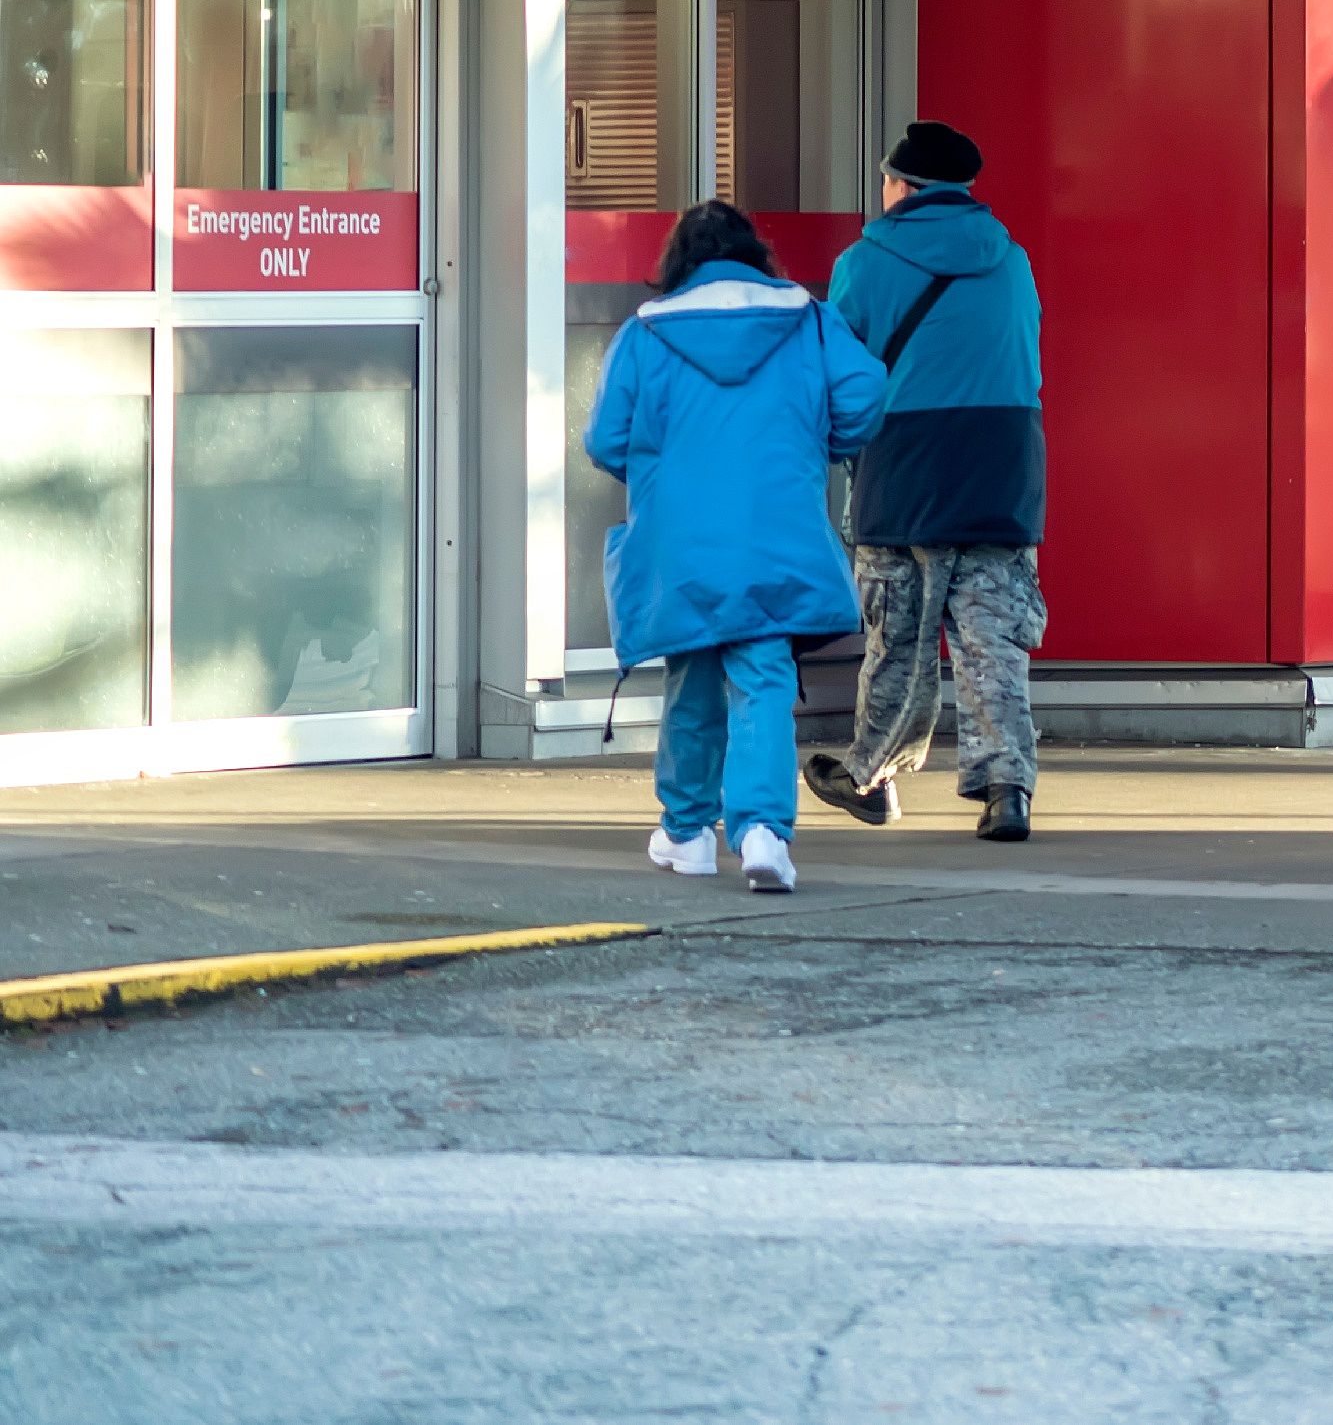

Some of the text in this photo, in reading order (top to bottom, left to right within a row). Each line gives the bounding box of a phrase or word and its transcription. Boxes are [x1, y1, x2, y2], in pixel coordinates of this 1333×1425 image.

[187, 203, 381, 241] Emergency Entrance
[260, 247, 311, 277] ONLY
